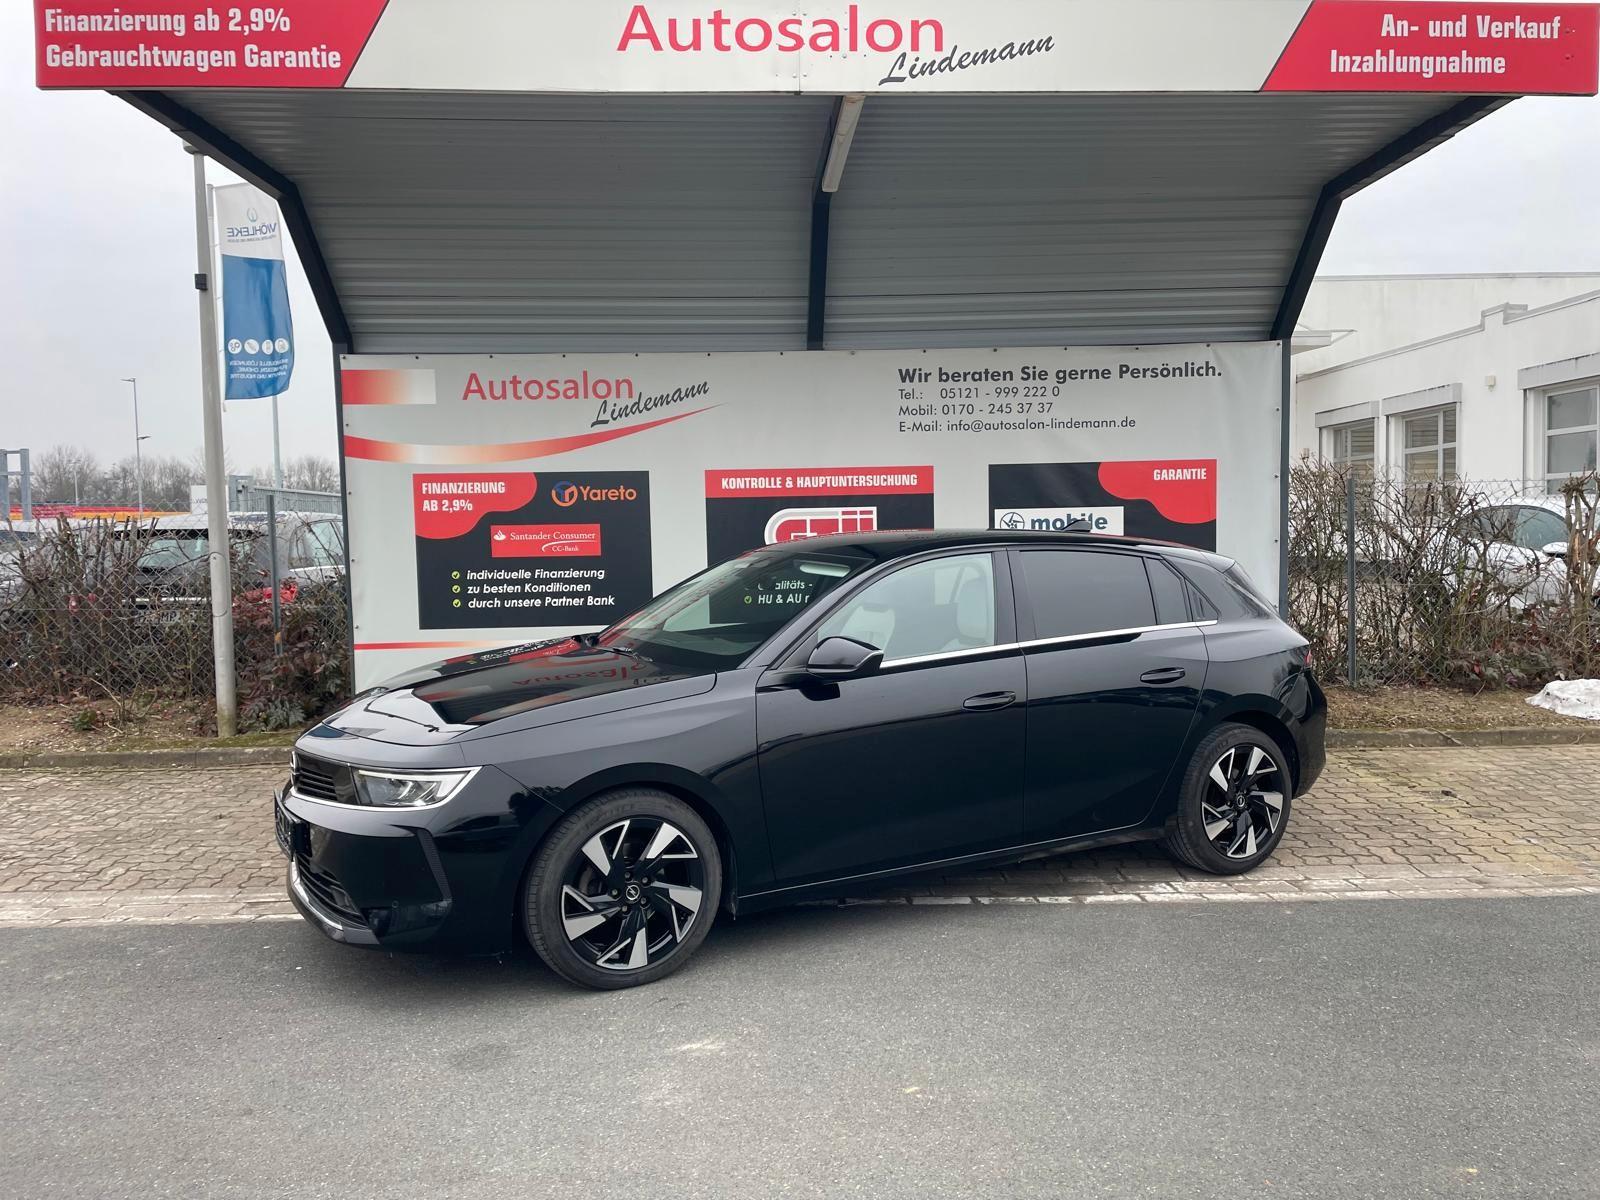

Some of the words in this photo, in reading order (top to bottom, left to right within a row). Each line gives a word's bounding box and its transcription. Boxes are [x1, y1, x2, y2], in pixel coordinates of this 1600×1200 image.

[45, 8, 186, 37] Finanzierung
[193, 8, 220, 32] ab
[228, 7, 292, 36] 2,9%
[617, 4, 943, 53] Autosalon
[1381, 13, 1419, 38] An-
[1428, 15, 1467, 38] und
[1476, 15, 1561, 39] Verkauf
[45, 44, 236, 72] Gebrauchtwagen
[244, 44, 342, 69] Garantie
[879, 34, 1055, 86] Lindemann
[1330, 49, 1506, 78] Inzahlungnahme
[898, 367, 931, 383] Wir
[938, 365, 1015, 383] beraten
[1020, 365, 1049, 381] Sie
[1055, 366, 1112, 385] gerne
[1118, 361, 1222, 380] Persönlich.
[462, 370, 633, 401] Autosalon
[898, 387, 924, 400] Tel.:
[940, 386, 980, 399] 05121
[994, 386, 1019, 399] 999
[1023, 386, 1048, 398] 222
[1052, 385, 1060, 398] 0
[590, 380, 709, 428] Lindemann
[898, 403, 937, 416] Mobil:
[941, 403, 975, 415] 0170
[988, 402, 1013, 414] 245
[1016, 402, 1034, 414] 37
[1037, 401, 1053, 414] 37
[899, 419, 943, 432] E-Mail:
[946, 416, 1136, 432] info@autosalon-lindemann.de
[721, 476, 782, 490] KONTROLLE
[785, 476, 794, 489] &
[796, 474, 918, 488] HAUPTUNTERSUCHUNG
[1153, 468, 1207, 481] GARANTIE
[421, 481, 506, 495] FINANZIERUNG
[579, 485, 637, 501] Yareto
[422, 499, 439, 512] AB
[441, 499, 473, 513] 2,9%
[509, 531, 552, 541] Santander
[552, 531, 596, 541] Consumer
[551, 545, 580, 553] CC-Bank
[466, 569, 532, 580] individuelle
[534, 568, 606, 581] Finanzierung
[467, 584, 482, 594] zu
[483, 583, 523, 594] besten
[525, 582, 591, 593] Konditionen
[758, 580, 805, 591] alitäts
[468, 597, 501, 608] durch
[504, 598, 541, 608] unsere
[545, 596, 585, 607] Partner
[587, 595, 615, 606] Bank
[758, 594, 773, 604] HU
[775, 594, 784, 604] &
[786, 593, 802, 603] AU
